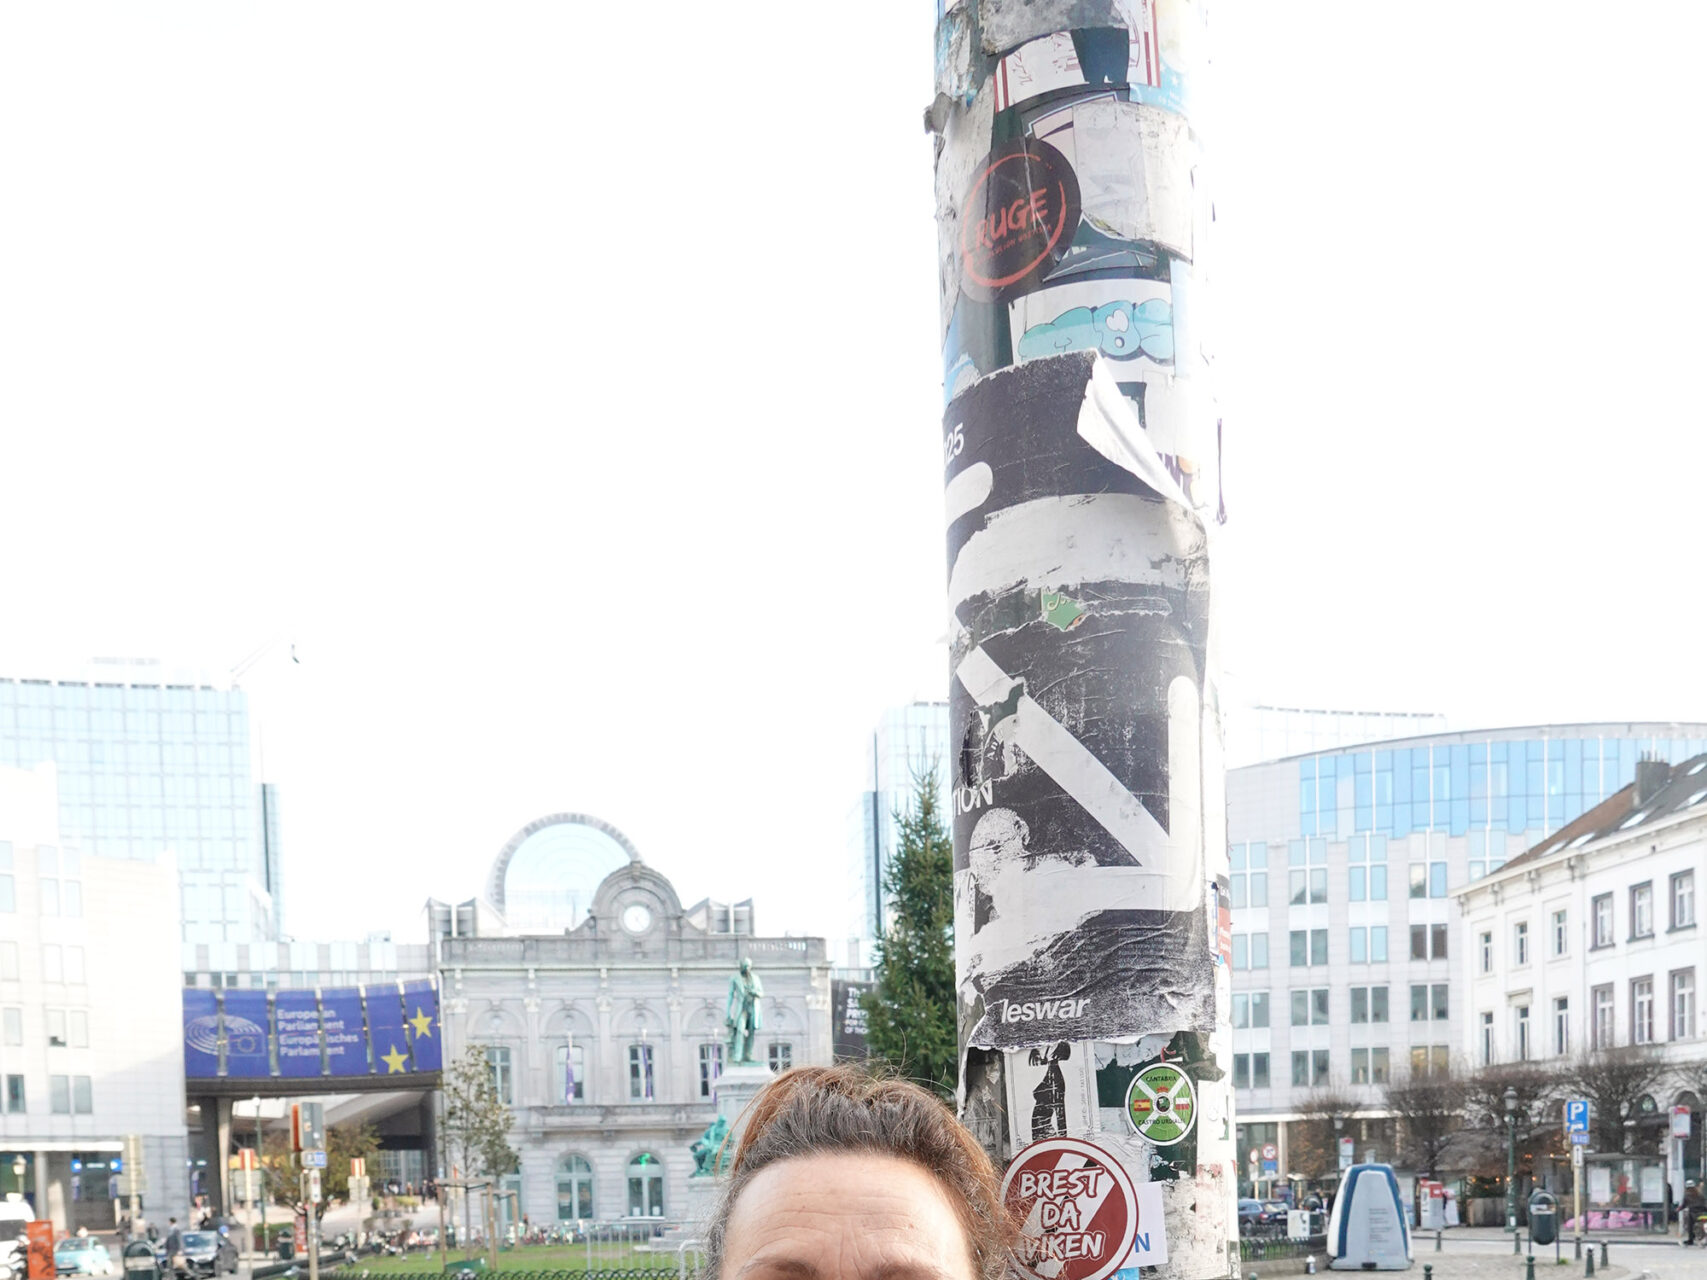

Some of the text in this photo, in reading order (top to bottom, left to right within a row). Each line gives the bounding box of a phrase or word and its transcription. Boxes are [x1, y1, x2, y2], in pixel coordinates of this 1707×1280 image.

[279, 1033, 359, 1045] Europäsches
[1571, 1103, 1584, 1120] P
[1020, 1168, 1104, 1199] BREST
[1042, 1200, 1081, 1231] DA
[1024, 1231, 1105, 1260] VIKEN
